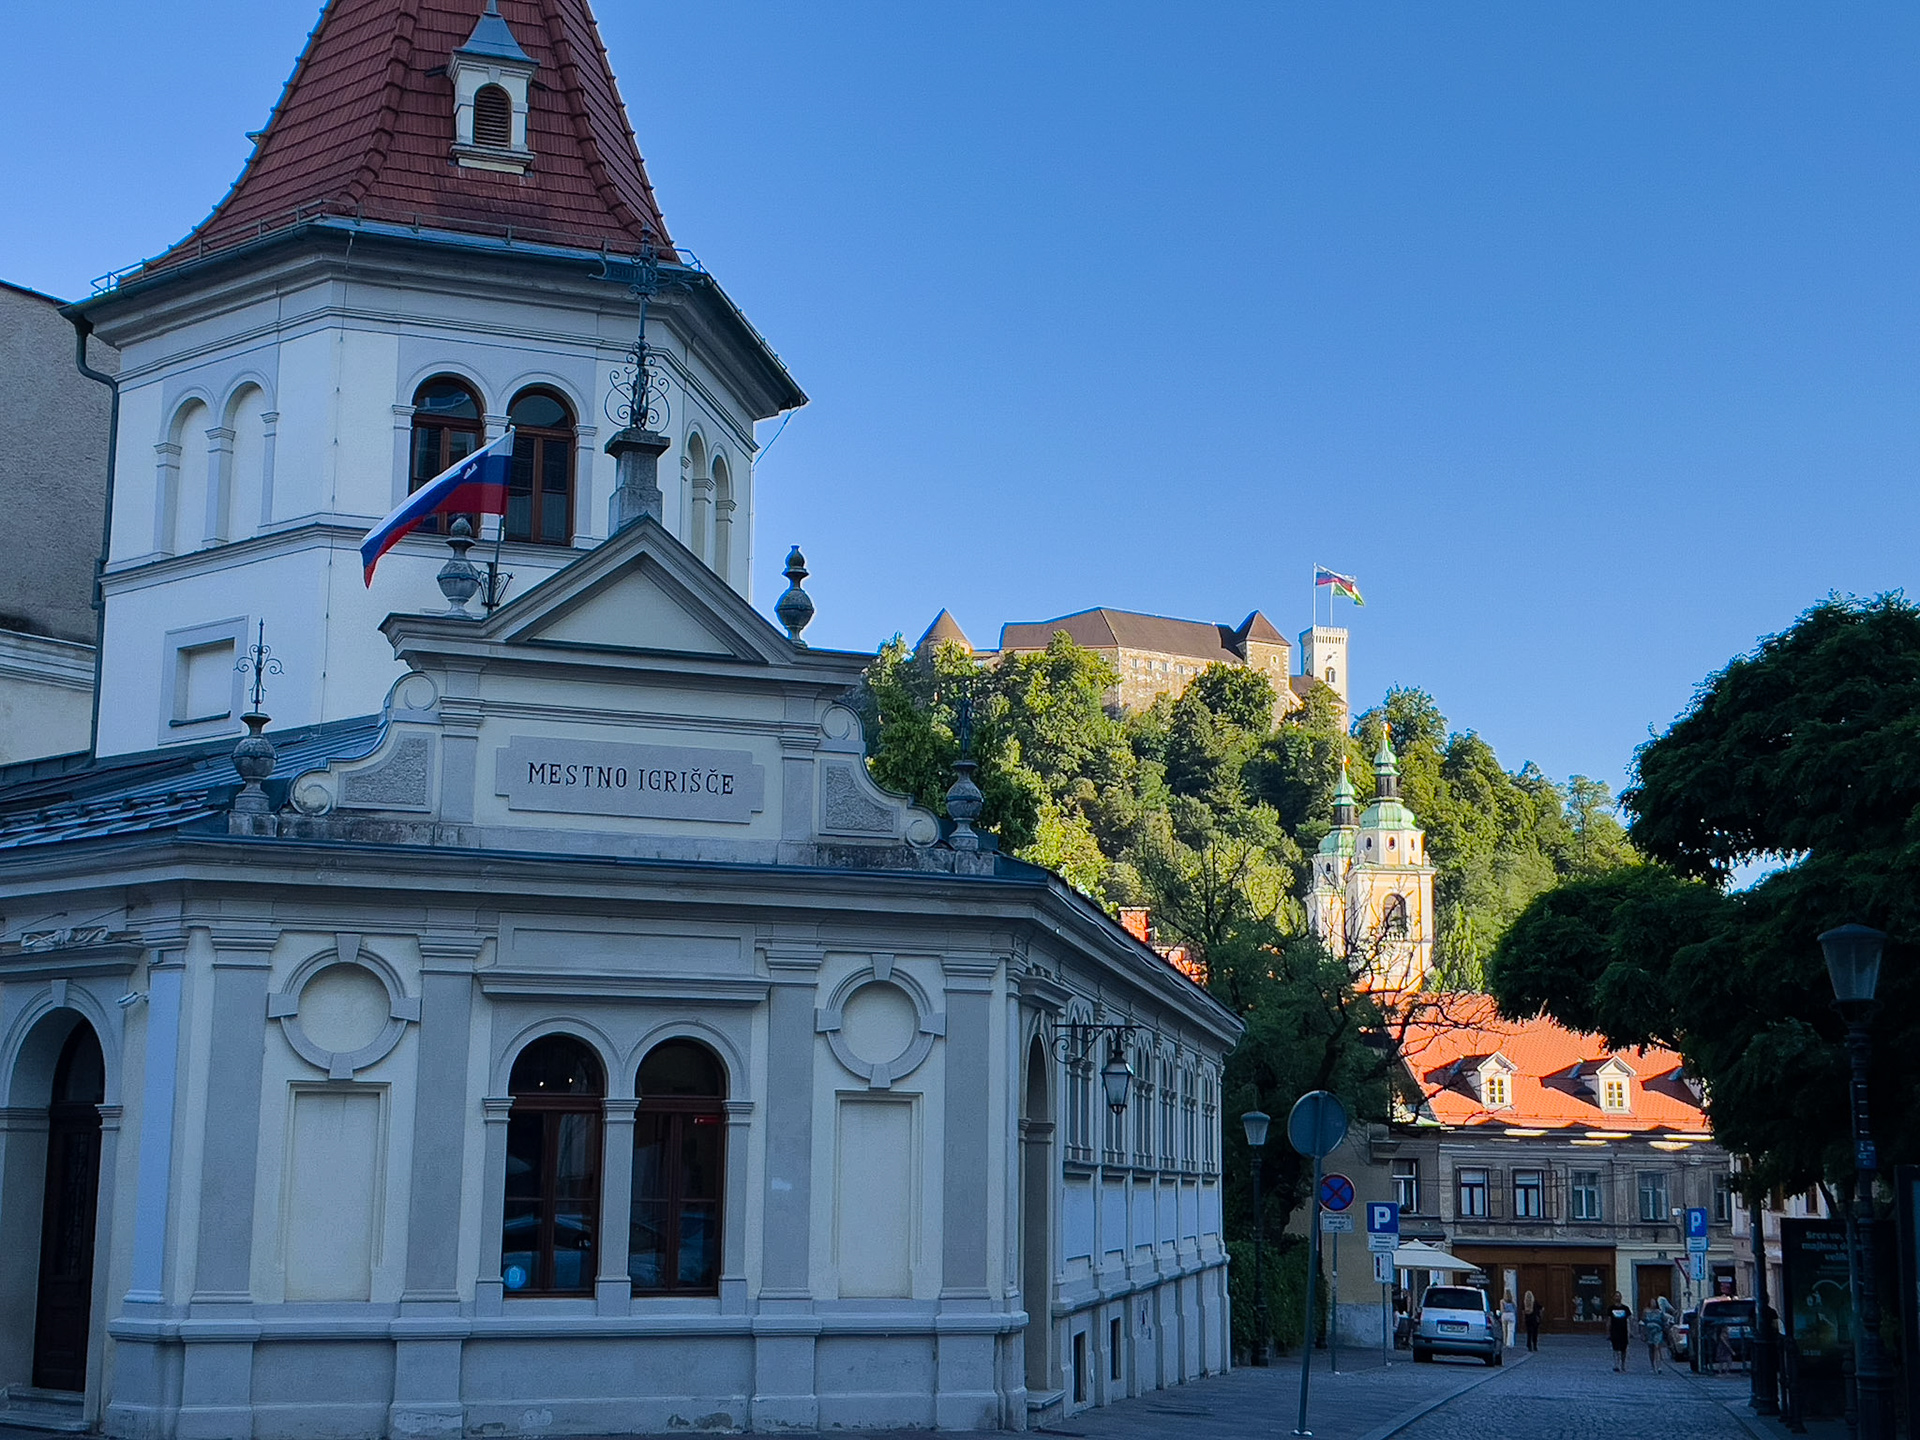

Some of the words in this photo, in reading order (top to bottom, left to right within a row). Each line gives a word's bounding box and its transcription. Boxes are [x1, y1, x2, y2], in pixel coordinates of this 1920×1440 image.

[527, 761, 627, 788] MESTNO
[638, 767, 734, 795] IGRIŠČE
[1373, 1206, 1391, 1229] P
[1690, 1212, 1702, 1232] P
